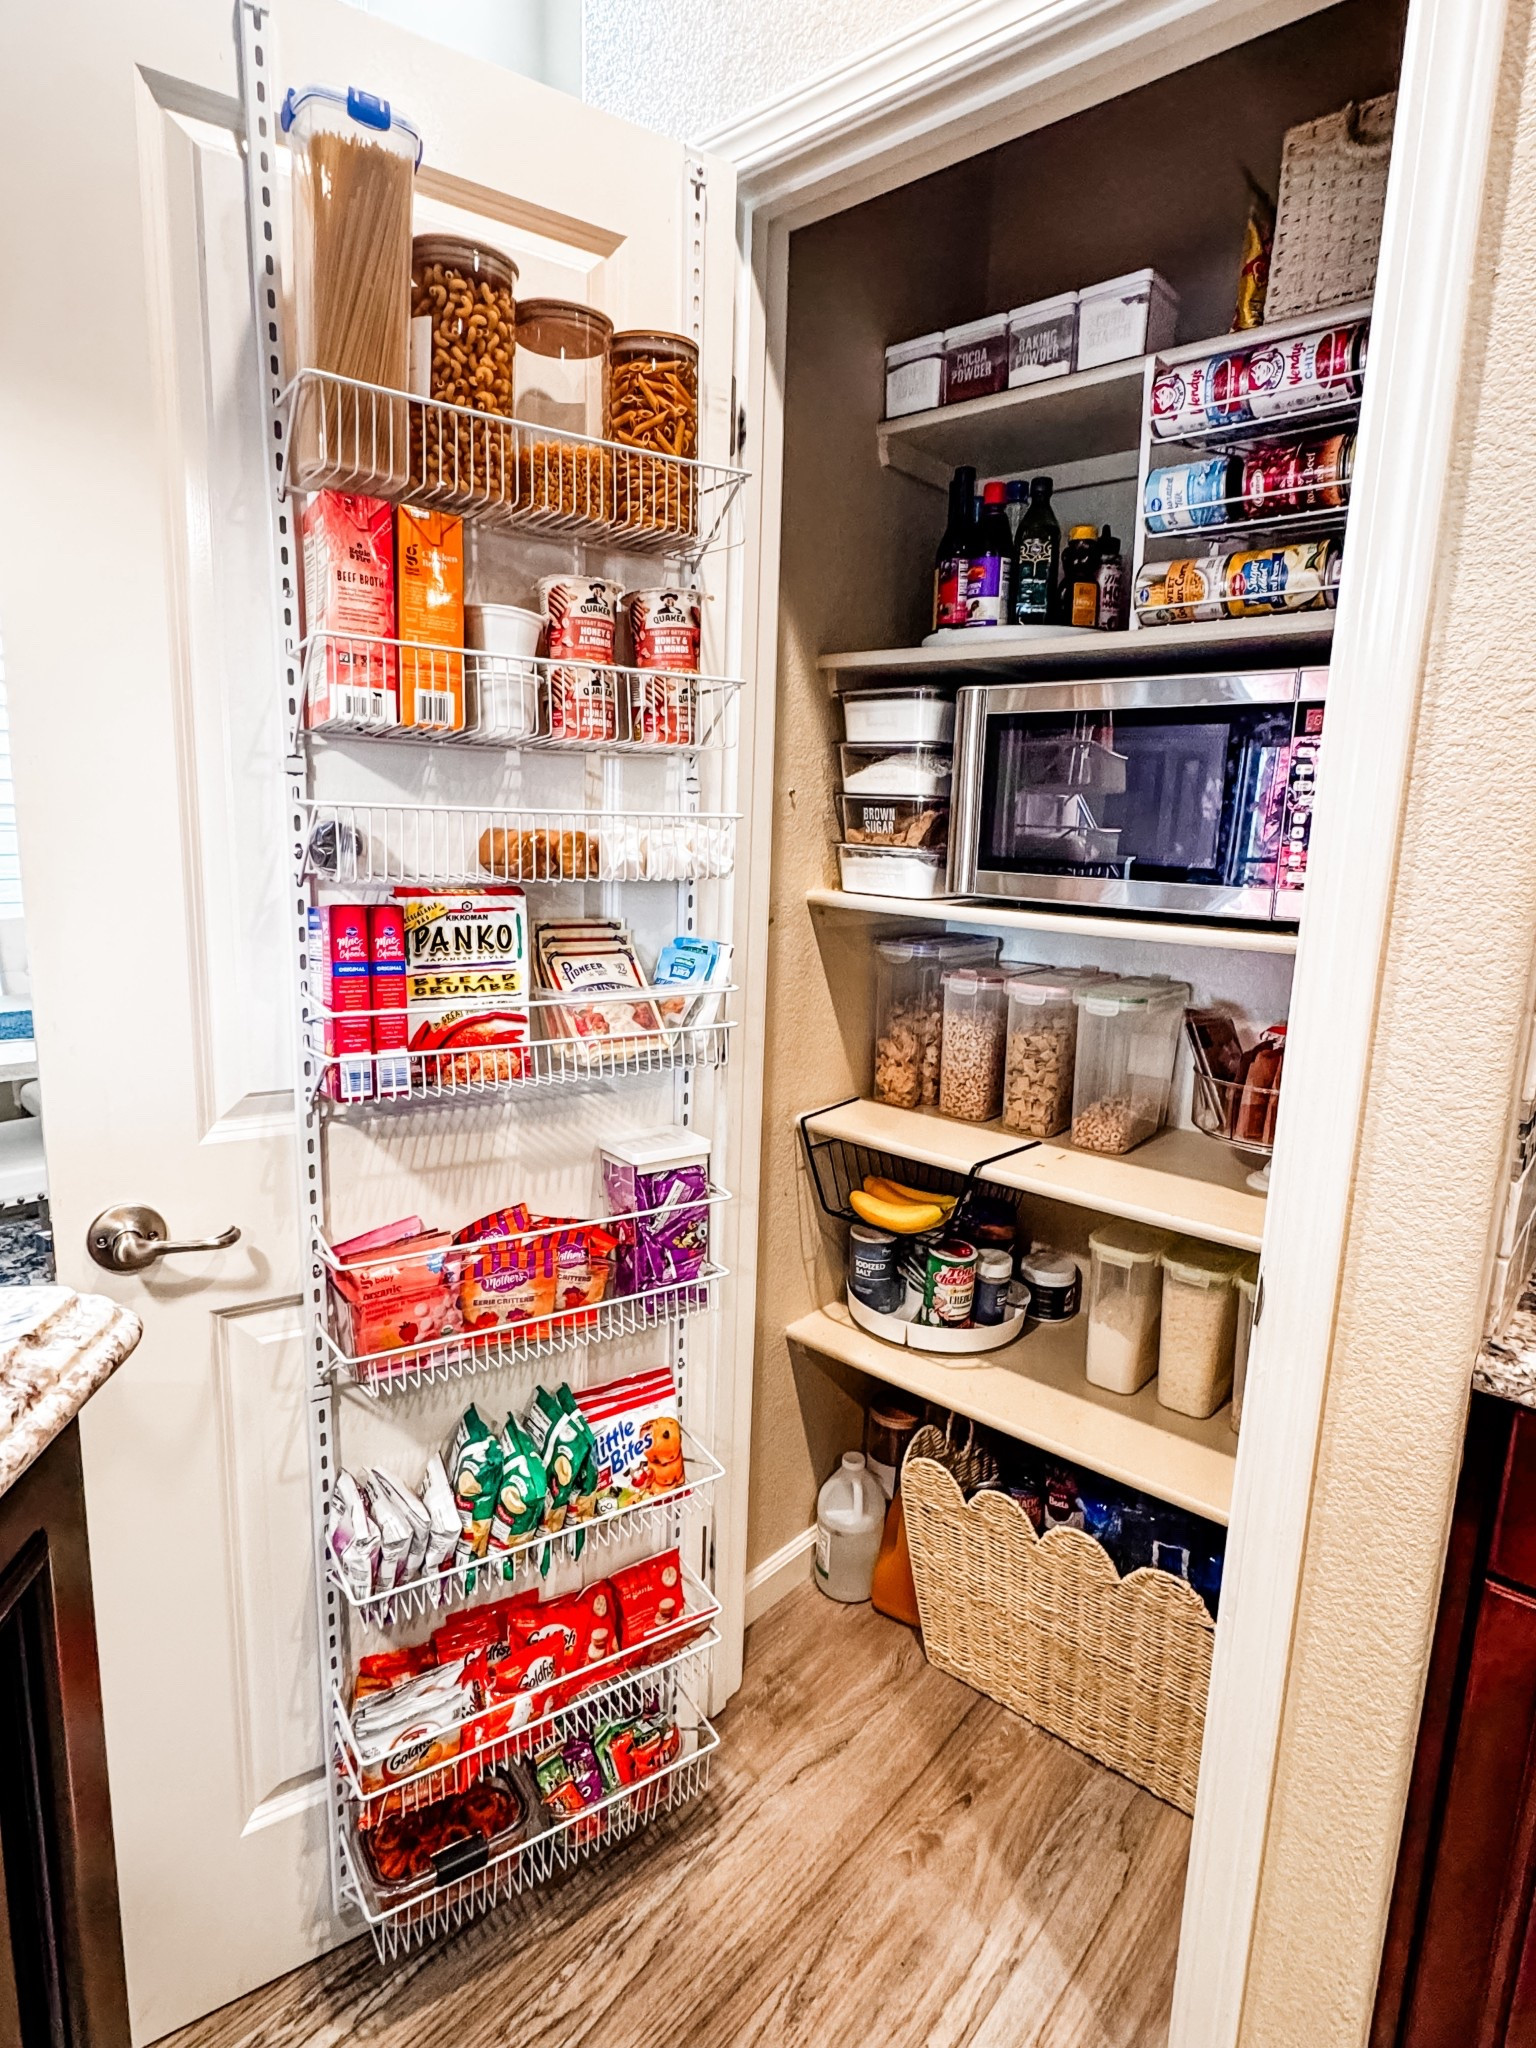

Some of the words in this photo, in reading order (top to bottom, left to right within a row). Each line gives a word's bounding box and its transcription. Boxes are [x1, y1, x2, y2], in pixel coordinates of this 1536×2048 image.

[1018, 328, 1058, 354] BAKING
[957, 347, 988, 369] COCOA
[1015, 344, 1060, 368] POWDER
[1304, 343, 1316, 380] CHILI
[951, 360, 992, 385] POWDER
[336, 569, 357, 583] BEEF
[359, 573, 385, 589] BROTH
[1174, 562, 1190, 587] Corn
[1247, 560, 1260, 592] Sugar
[1166, 576, 1175, 605] WEET
[580, 603, 611, 617] QUAKER
[653, 613, 687, 625] QUAKER
[580, 626, 605, 638] HONEY
[605, 629, 611, 639] &
[578, 634, 612, 649] ALMONDS
[654, 635, 682, 646] HONEY
[681, 636, 688, 645] &
[654, 644, 689, 655] ALMONDS
[862, 806, 896, 822] BROWN
[864, 820, 895, 835] SUGAR
[445, 913, 489, 921] KIKKOMAN
[336, 936, 364, 950] Mac
[374, 936, 401, 950] Mac
[412, 923, 513, 956] PANKO
[413, 973, 516, 987] BREAD
[561, 961, 606, 985] PIONEER
[414, 982, 516, 997] CRUMBS
[855, 1259, 886, 1271] IODIZED
[855, 1267, 872, 1277] SALT
[374, 1275, 394, 1284] baby
[557, 1273, 592, 1282] CRITTERS
[363, 1285, 402, 1301] organic
[473, 1297, 496, 1307] EERIE
[496, 1295, 535, 1305] CRITTERS
[592, 1420, 636, 1467] Little
[610, 1431, 653, 1475] Bites
